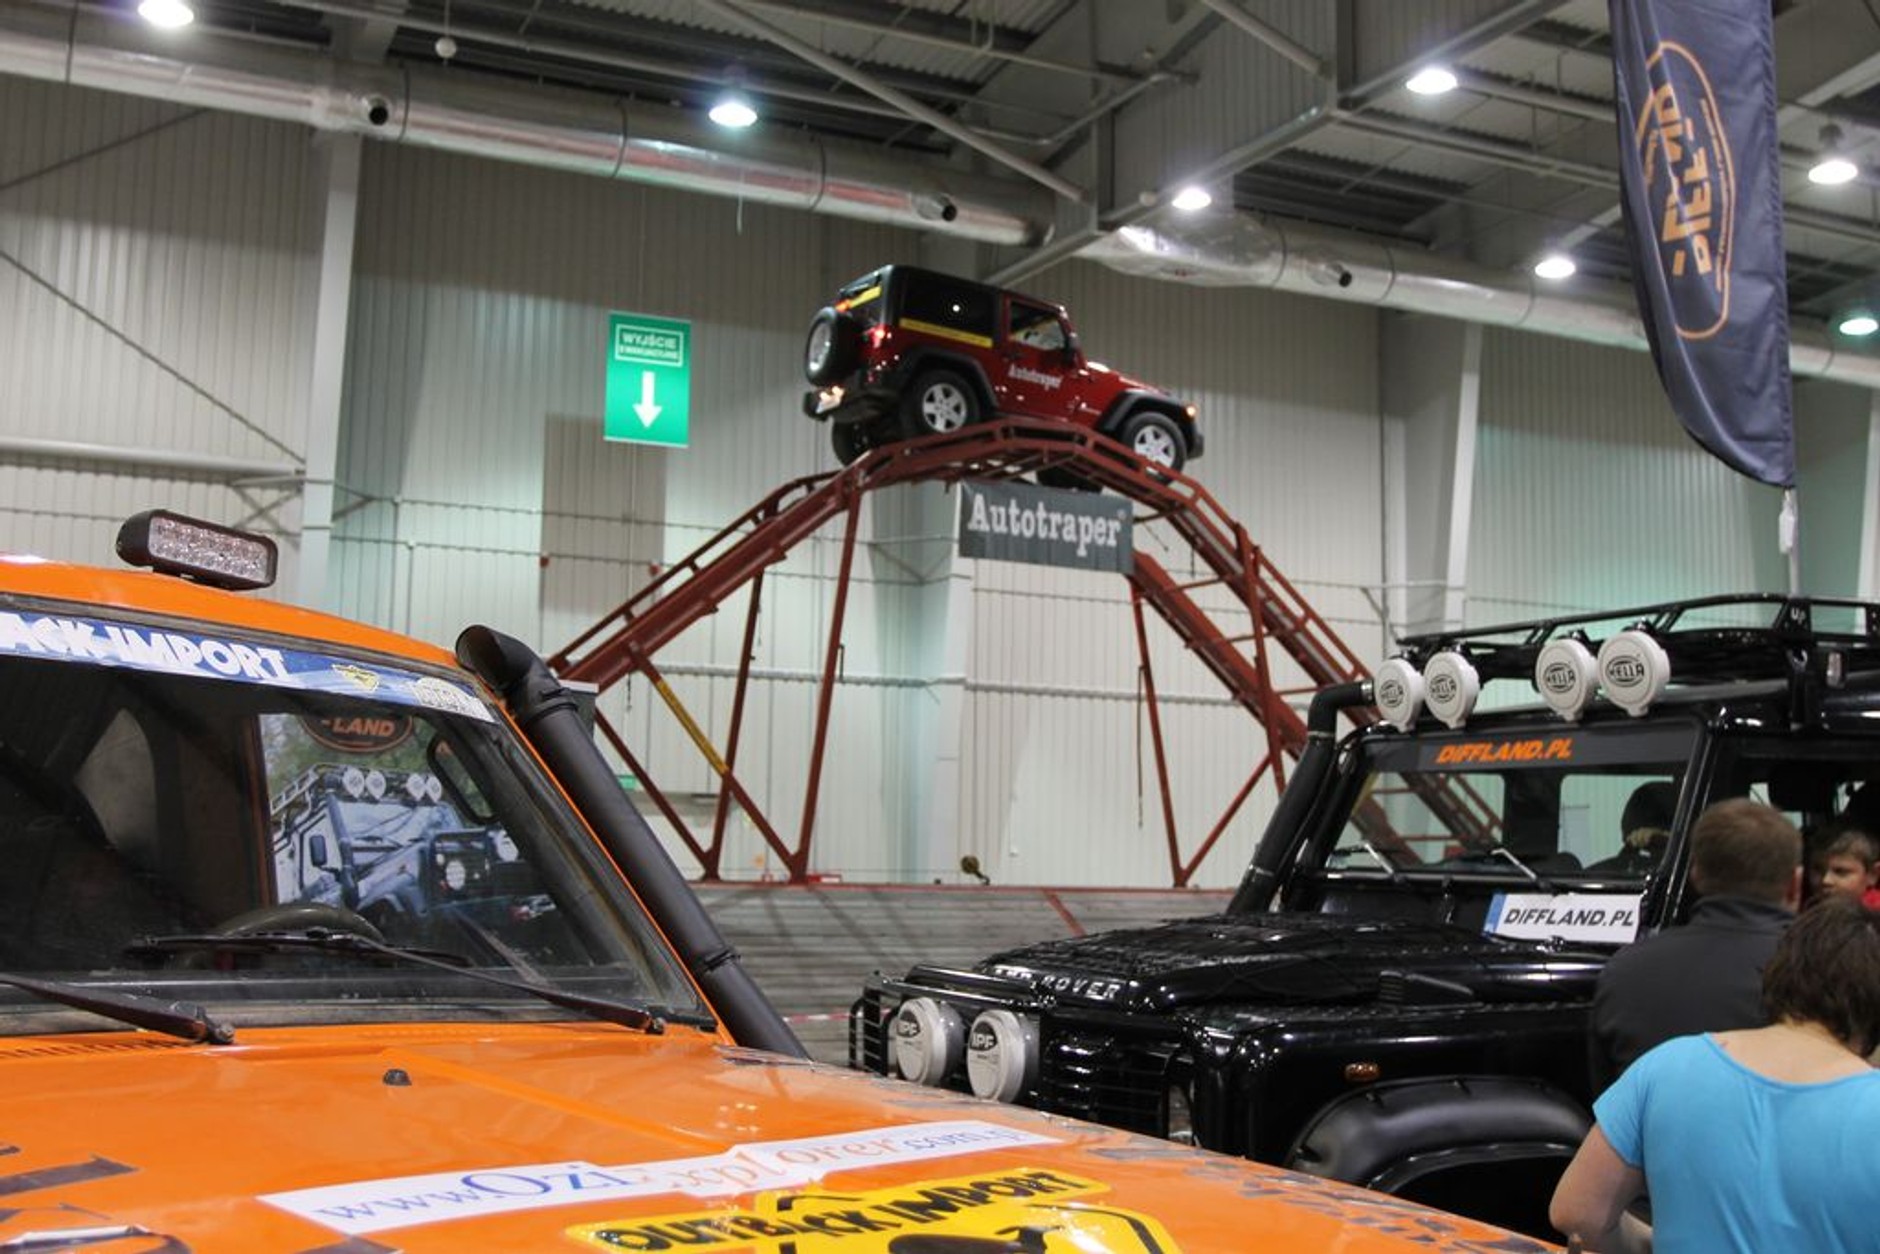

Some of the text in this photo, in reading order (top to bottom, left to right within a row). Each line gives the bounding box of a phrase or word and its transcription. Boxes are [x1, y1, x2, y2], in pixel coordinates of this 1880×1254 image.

[1436, 738, 1574, 764] DIFFLAND.PL
[1504, 908, 1634, 927] DIFFLAND.PL
[1041, 974, 1121, 1001] ROVER
[971, 1033, 995, 1049] IPF
[869, 1171, 1088, 1224] IMPORT
